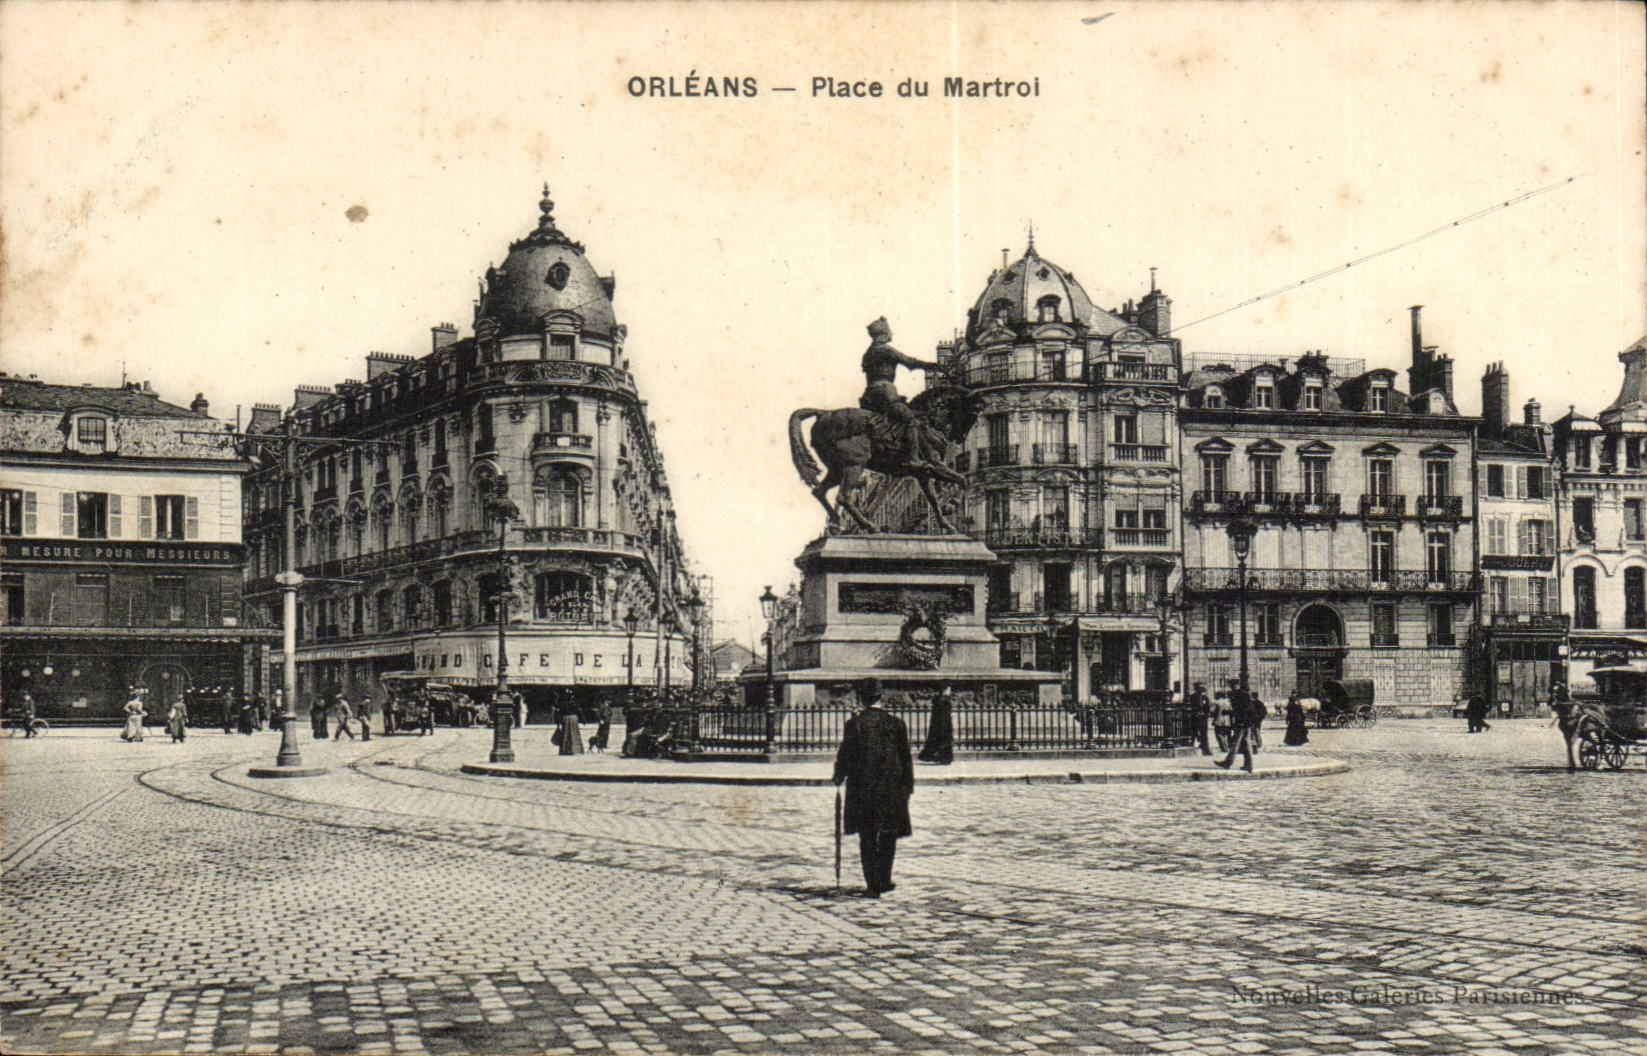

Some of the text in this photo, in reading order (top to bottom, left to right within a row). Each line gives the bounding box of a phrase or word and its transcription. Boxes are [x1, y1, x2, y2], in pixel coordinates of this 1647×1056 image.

[21, 546, 81, 558] MESURE
[95, 548, 133, 559] POUR
[146, 548, 231, 561] MESSIEURS
[574, 652, 602, 668] DE
[621, 653, 642, 668] LA
